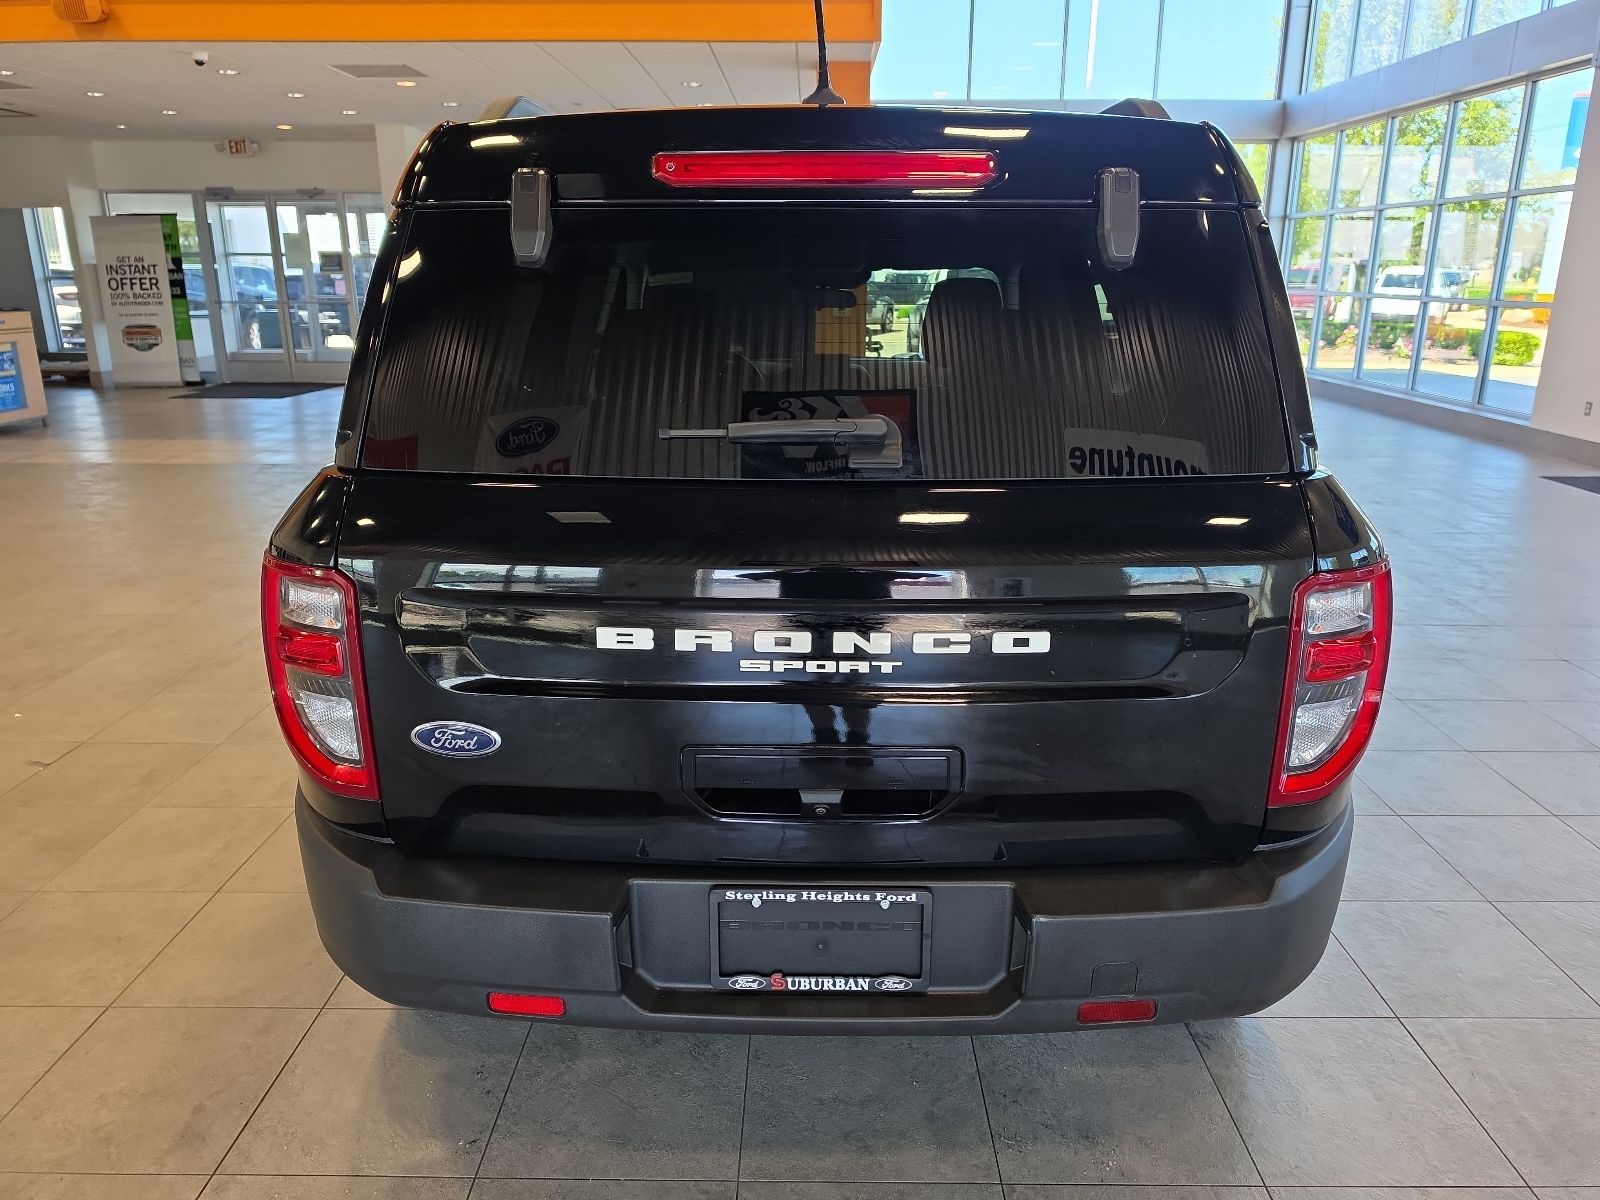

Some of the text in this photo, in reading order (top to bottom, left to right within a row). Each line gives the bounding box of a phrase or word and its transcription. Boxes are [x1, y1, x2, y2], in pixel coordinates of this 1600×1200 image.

[228, 139, 247, 154] EXIT
[116, 256, 144, 264] GET AN
[105, 264, 158, 276] INSTANT
[107, 277, 160, 291] OFFER
[110, 292, 163, 300] 100% BACKED
[596, 626, 1051, 654] BRONCO
[739, 659, 903, 673] SPORT
[430, 728, 478, 750] Ford
[725, 891, 917, 903] Sterling Heights Ford
[770, 973, 870, 991] SUBURBAN
